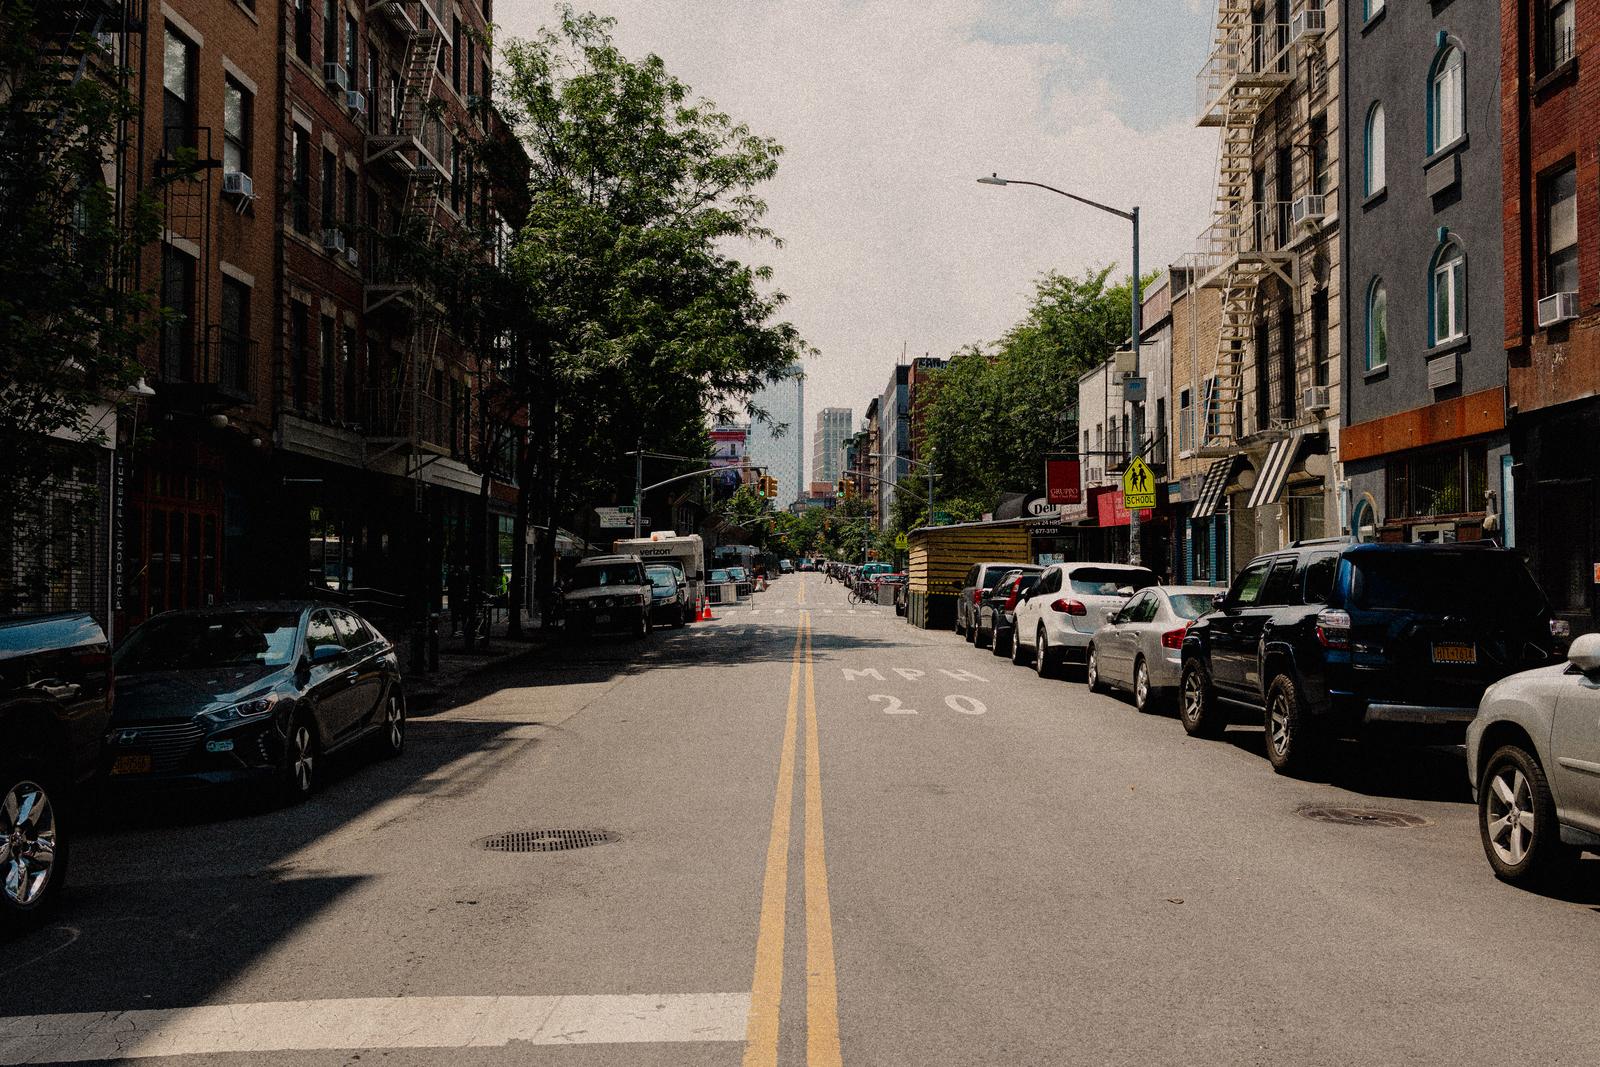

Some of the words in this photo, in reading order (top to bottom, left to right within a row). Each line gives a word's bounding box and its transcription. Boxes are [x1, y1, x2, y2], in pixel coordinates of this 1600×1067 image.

[1126, 496, 1153, 504] SCHOOL
[640, 548, 670, 556] verizon
[841, 667, 990, 682] MPH
[868, 694, 987, 715] 20
